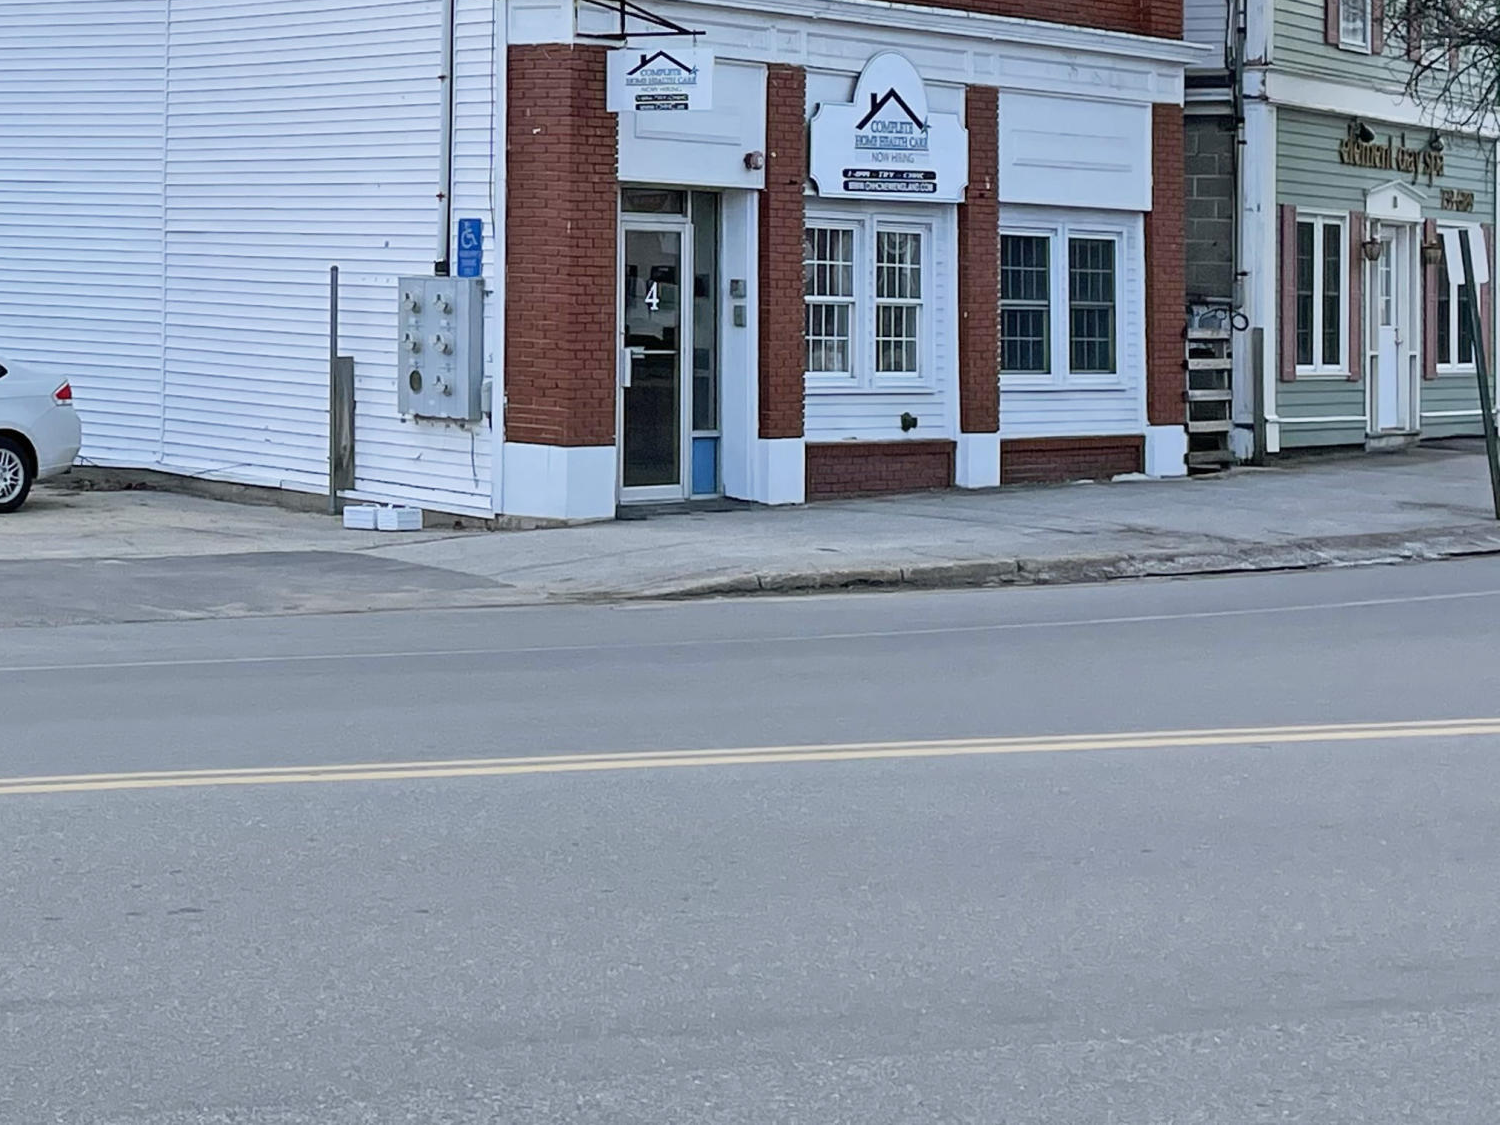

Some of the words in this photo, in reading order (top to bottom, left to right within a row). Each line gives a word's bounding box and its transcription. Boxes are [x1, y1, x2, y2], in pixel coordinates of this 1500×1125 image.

[870, 120, 914, 134] COMPLETE
[854, 135, 878, 147] HOME
[879, 136, 908, 148] HEALTH
[909, 136, 929, 149] CARE
[871, 152, 889, 163] NOW
[891, 152, 915, 164] HIRING
[1395, 132, 1421, 186] day
[644, 281, 660, 311] 4
